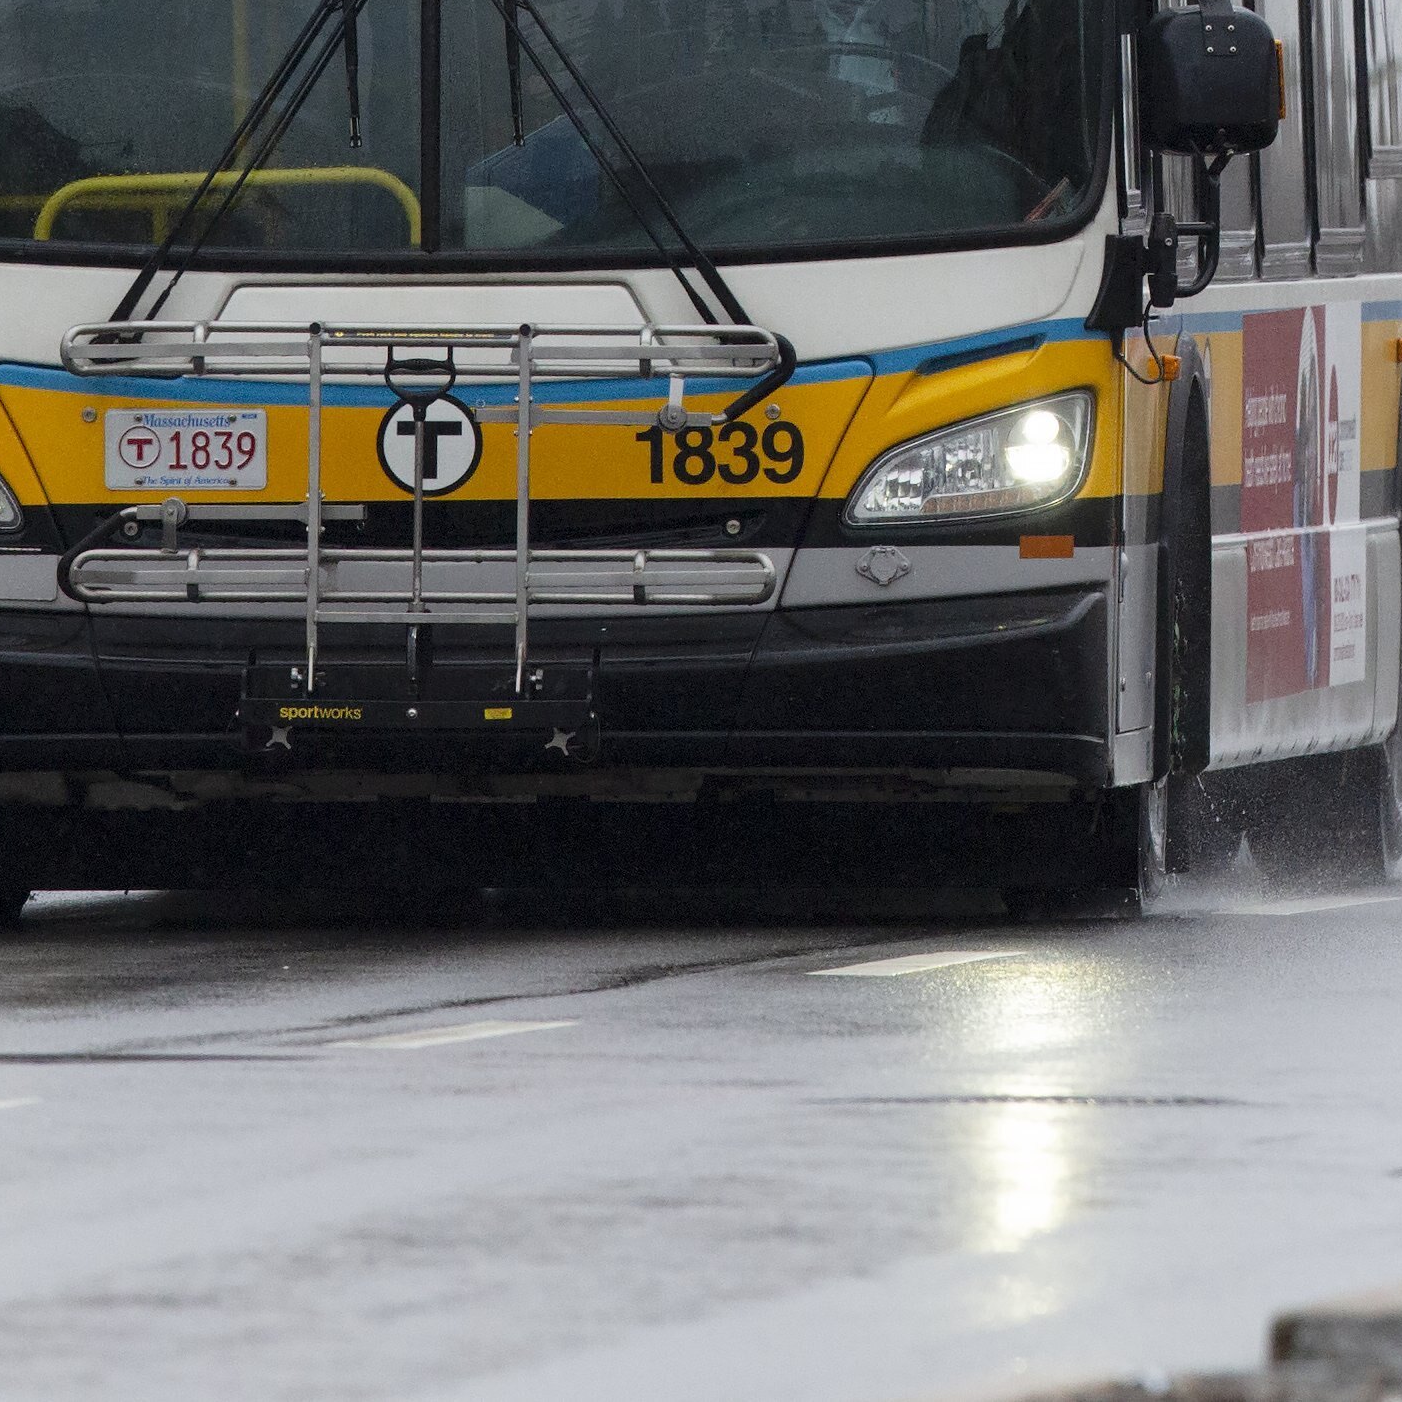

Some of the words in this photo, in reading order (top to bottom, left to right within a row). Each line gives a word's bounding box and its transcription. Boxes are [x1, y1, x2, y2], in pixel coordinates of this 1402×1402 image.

[143, 413, 231, 428] Massachusetts
[168, 431, 256, 470] 1839
[397, 421, 462, 479] T
[635, 420, 805, 485] 1839
[143, 476, 157, 485] The
[159, 476, 182, 487] Spirit
[184, 475, 193, 486] of
[193, 476, 230, 485] America
[279, 705, 362, 721] sportworks
